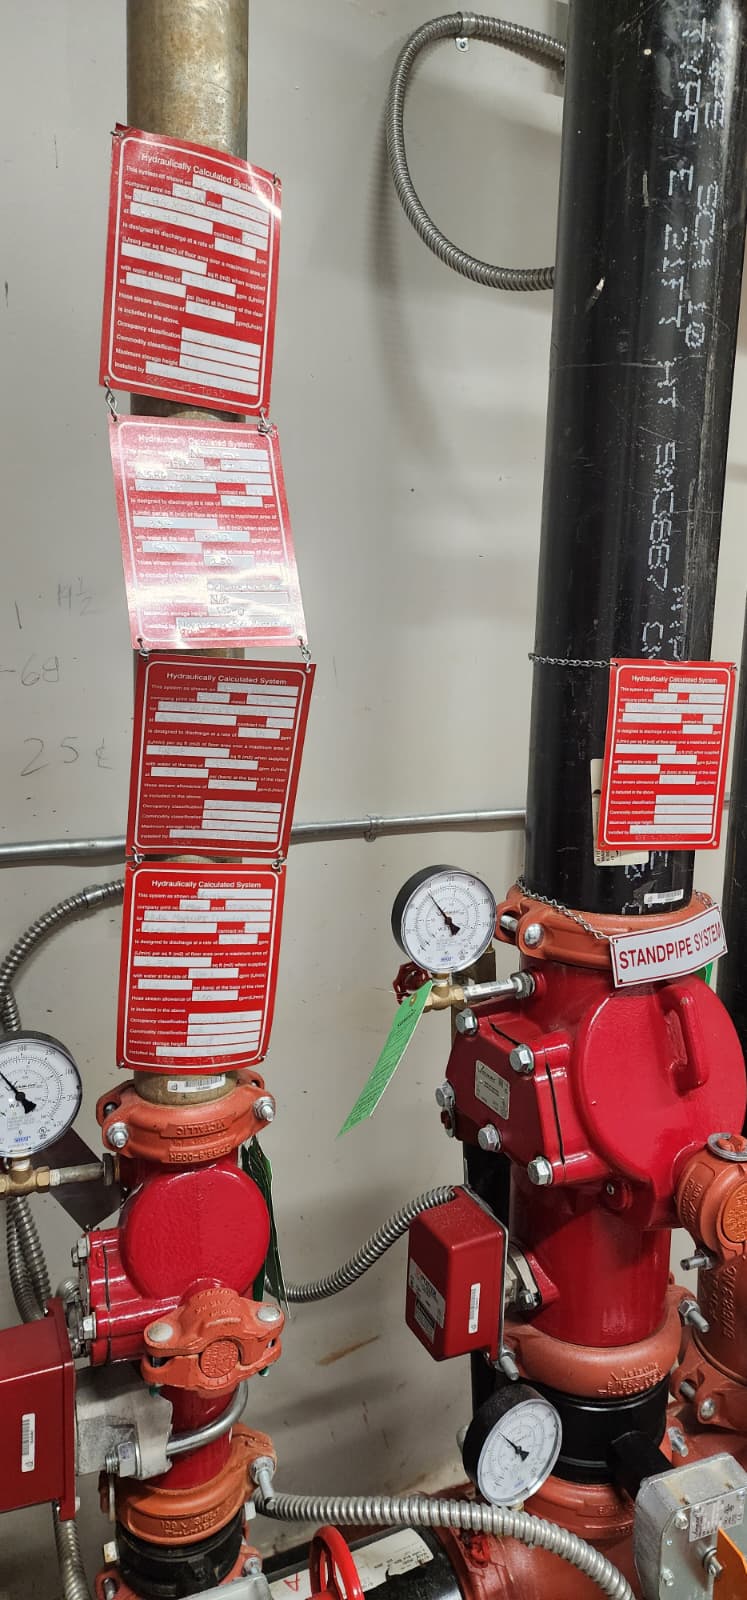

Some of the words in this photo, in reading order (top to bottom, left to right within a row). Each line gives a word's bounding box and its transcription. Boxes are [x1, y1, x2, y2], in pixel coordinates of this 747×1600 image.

[141, 152, 190, 174] Hydraulically
[192, 165, 230, 183] Calculated
[232, 177, 257, 195] System
[668, 165, 694, 196] E
[166, 671, 215, 682] Hydraulically
[218, 674, 257, 682] Calculated
[259, 677, 286, 686] System
[150, 880, 196, 888] Hydraulically
[237, 881, 261, 889] System
[619, 937, 693, 969] STANDPIPE
[694, 922, 721, 951] SYSTEM
